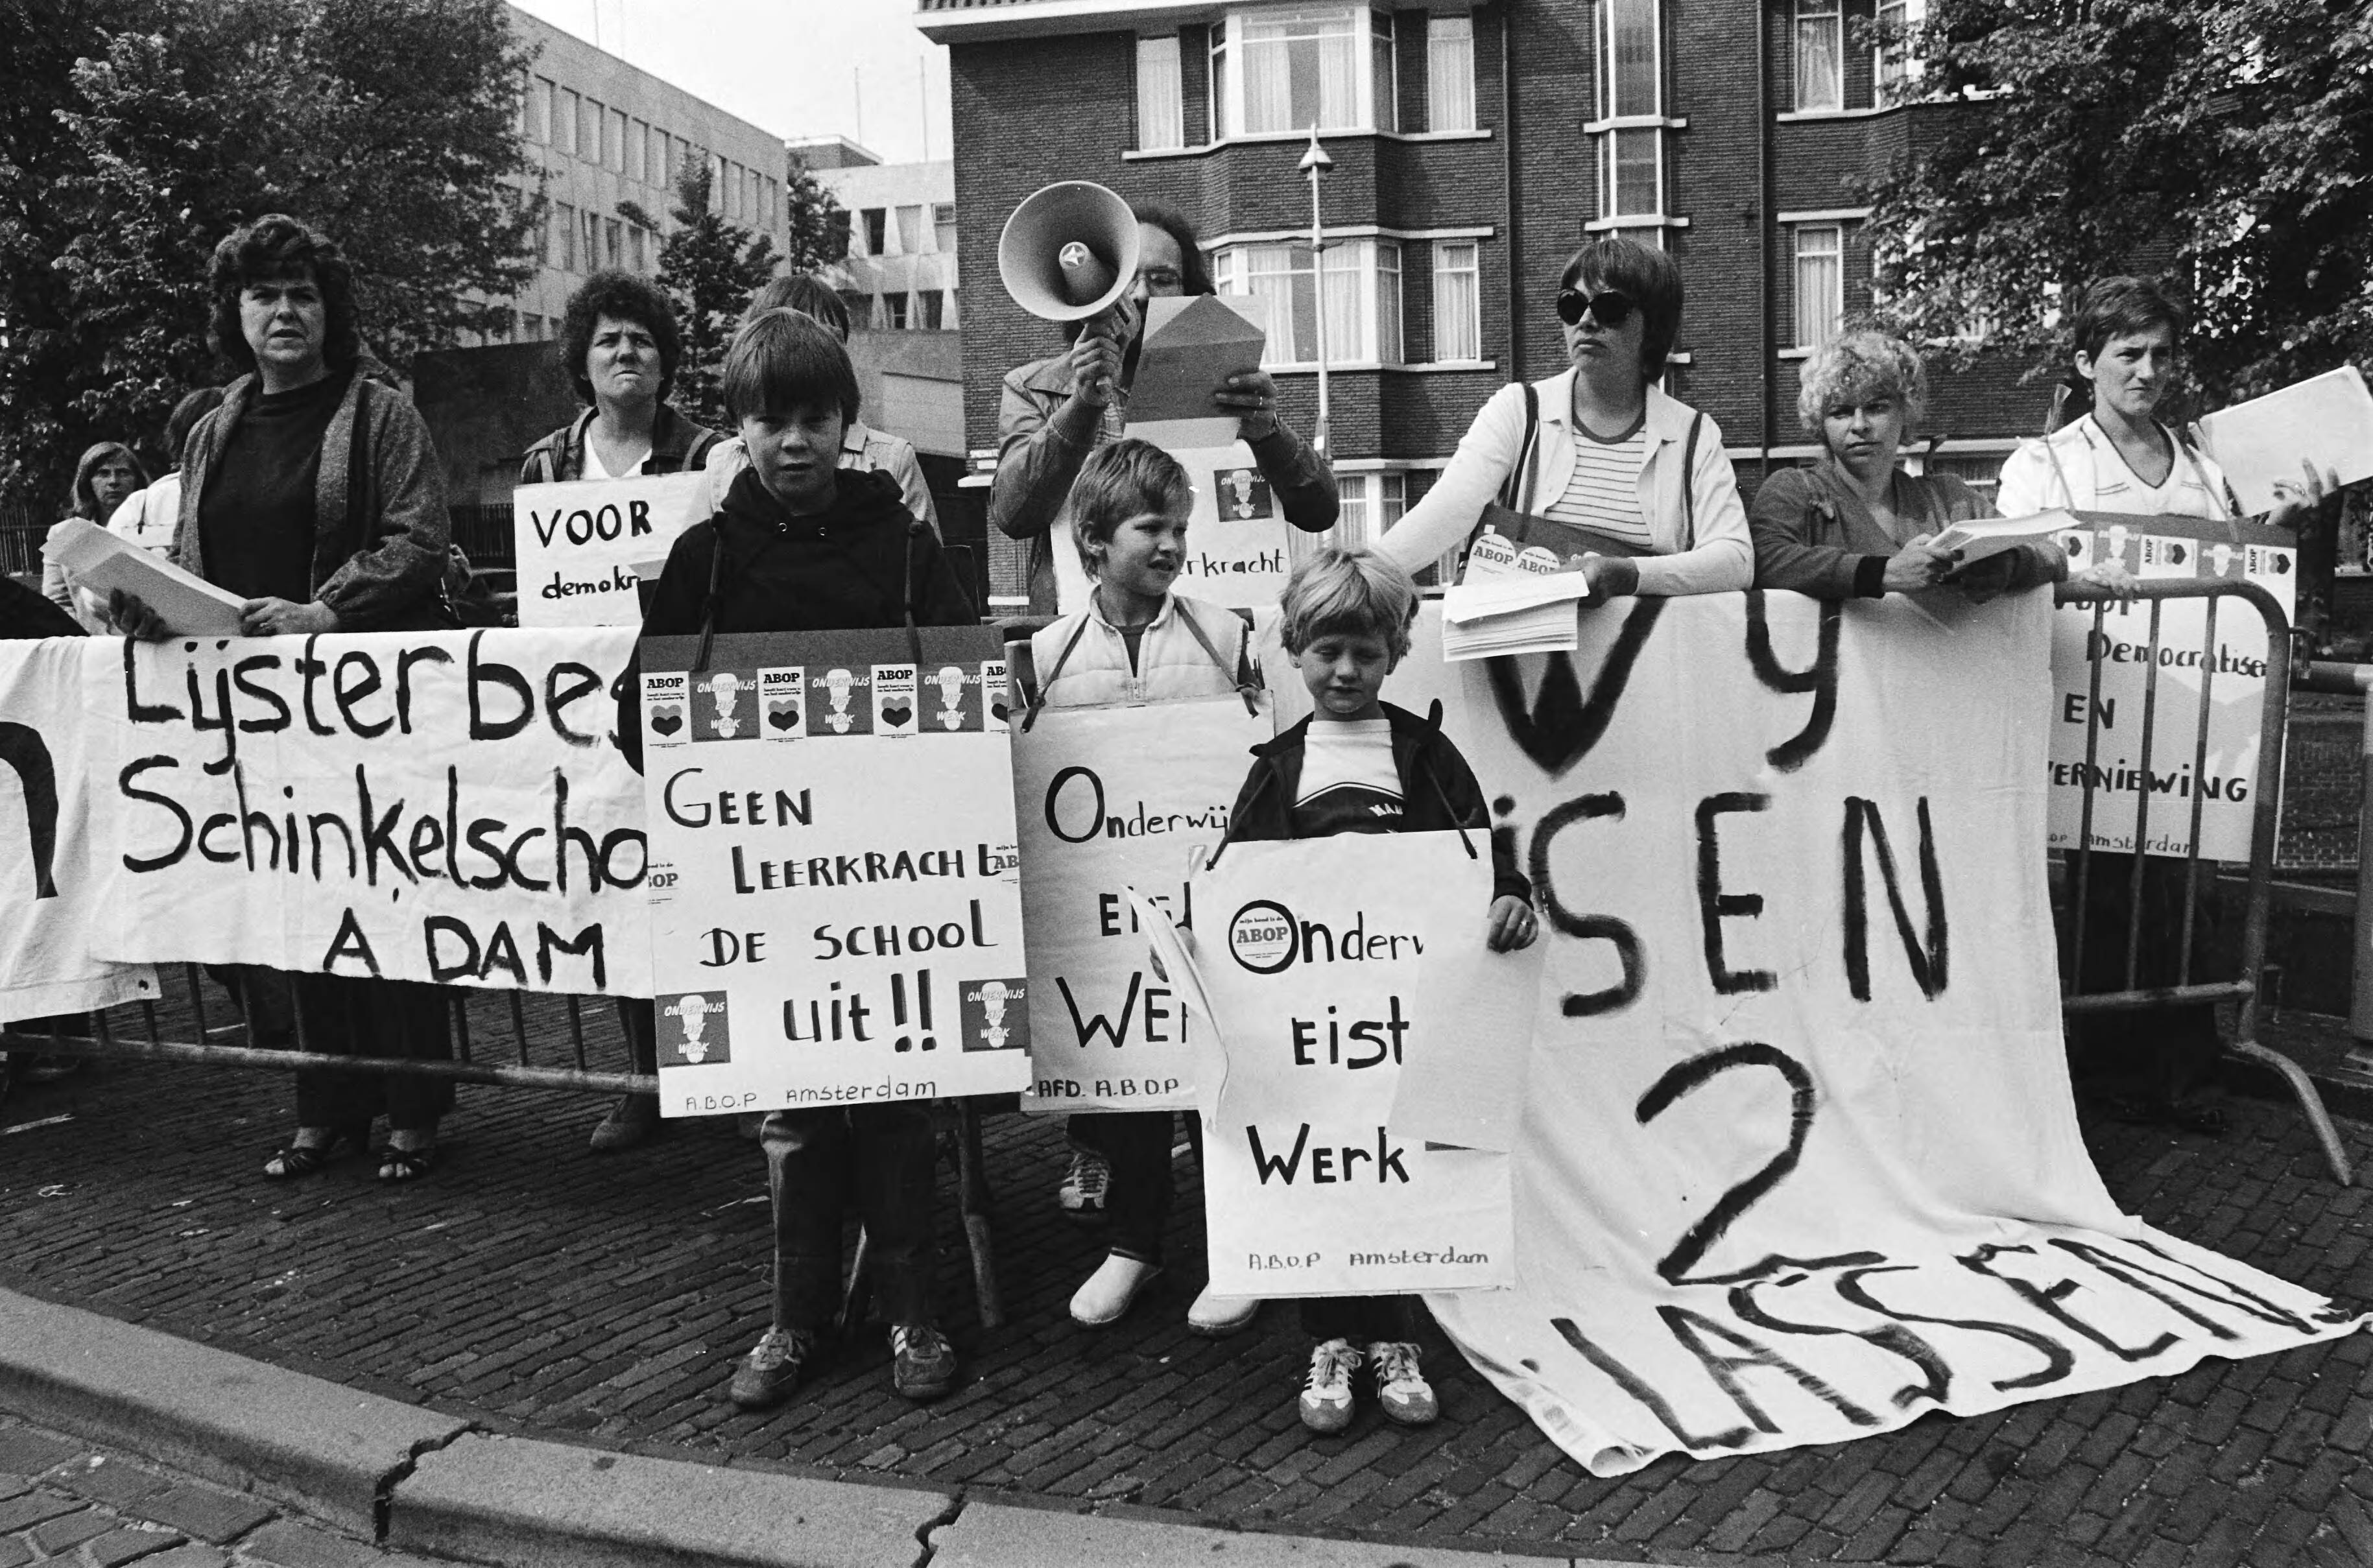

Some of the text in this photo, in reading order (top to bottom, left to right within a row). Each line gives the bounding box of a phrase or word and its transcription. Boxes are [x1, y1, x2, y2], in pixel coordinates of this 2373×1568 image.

[531, 500, 652, 547] VOOR
[1473, 545, 1514, 565] ABOP
[647, 678, 684, 689] ABOP
[763, 672, 800, 683] ABOP
[877, 670, 913, 680] ABOP
[699, 899, 999, 967] DE SCHOOL
[1237, 927, 1288, 944] ABOP
[787, 1075, 936, 1103] Amsterdam
[1636, 1040, 1889, 1287] 2
[1350, 1246, 1489, 1266] Amsterdam
